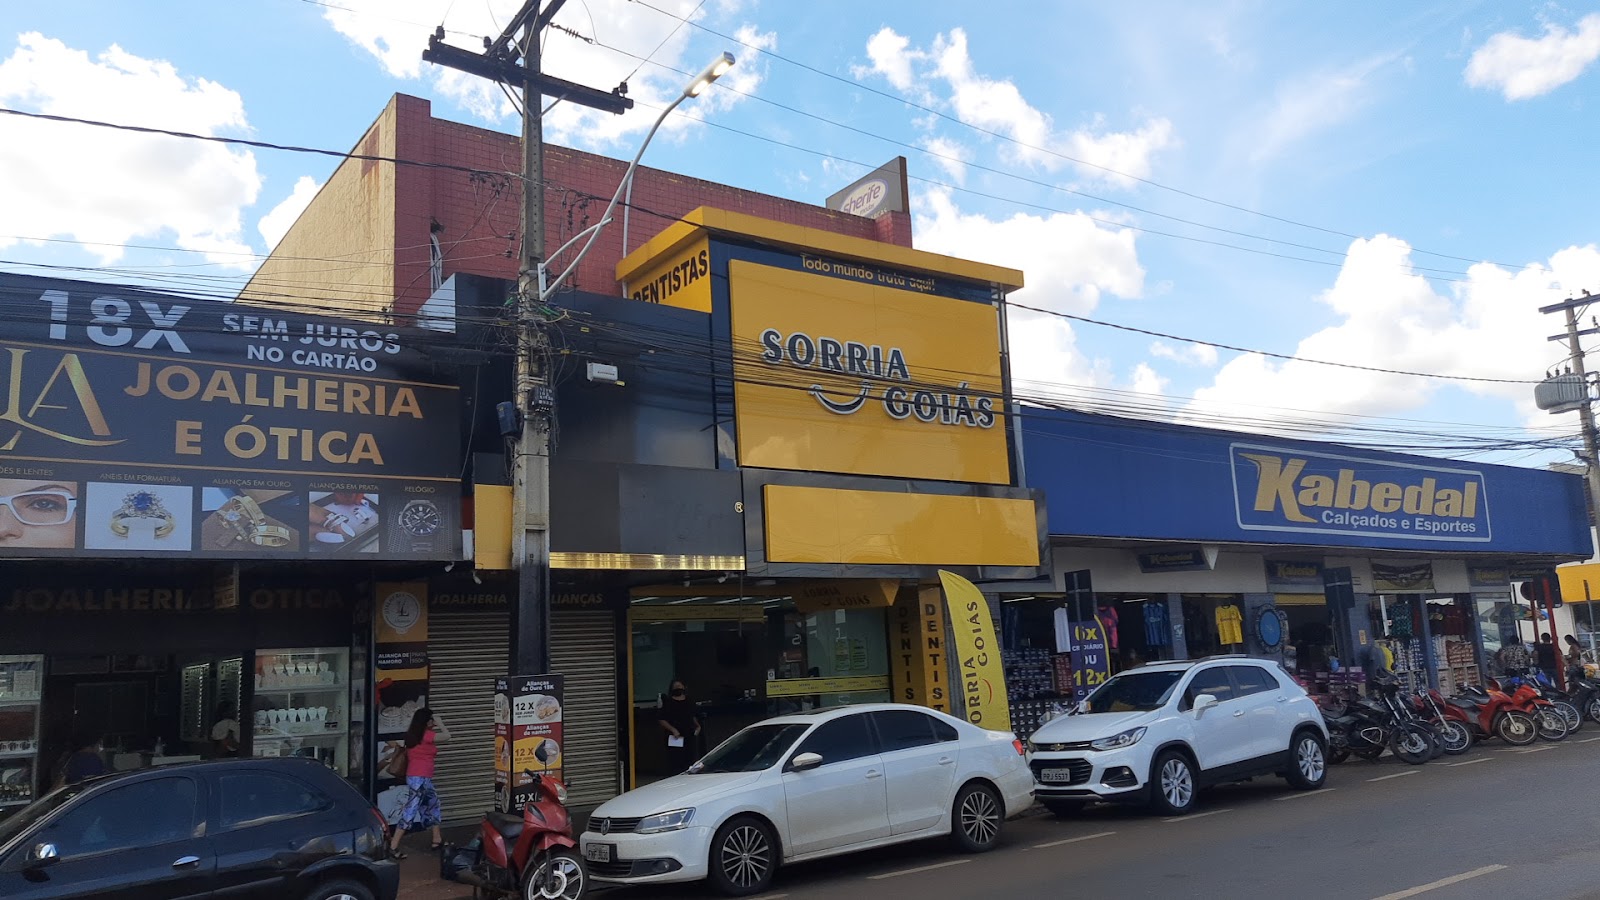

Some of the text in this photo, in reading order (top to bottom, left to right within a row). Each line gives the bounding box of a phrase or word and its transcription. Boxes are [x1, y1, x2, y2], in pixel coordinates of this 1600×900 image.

[800, 254, 831, 272] Todo
[833, 263, 874, 280] mundo
[39, 289, 191, 354] 18X
[222, 314, 401, 354] SEM JUROS
[247, 344, 378, 372] NO CARTÃO
[759, 327, 912, 380] SORRIA
[124, 362, 424, 419] JOALHERIA
[882, 380, 996, 428] GOIÁS
[175, 414, 385, 466] E ÓTICA
[23, 468, 54, 477] LENTES
[136, 474, 182, 484] FORMATURA
[212, 478, 252, 488] ALIANÇAS
[266, 480, 292, 488] OURO
[309, 482, 346, 491] ALIANÇAS
[358, 483, 380, 491] PRATA
[404, 485, 436, 494] RELÓGIO
[1238, 453, 1478, 524] Kabedal
[1321, 510, 1477, 533] Calçados e Esportes
[431, 592, 604, 607] JOALHERIA LIANÇAS
[966, 601, 988, 667] GOIÁS
[526, 680, 550, 689] Alianças
[964, 656, 982, 724] ORRIA
[515, 702, 534, 710] 12 X
[526, 724, 550, 733] Alianças
[515, 748, 534, 757] 12 X
[515, 794, 527, 803] 12
